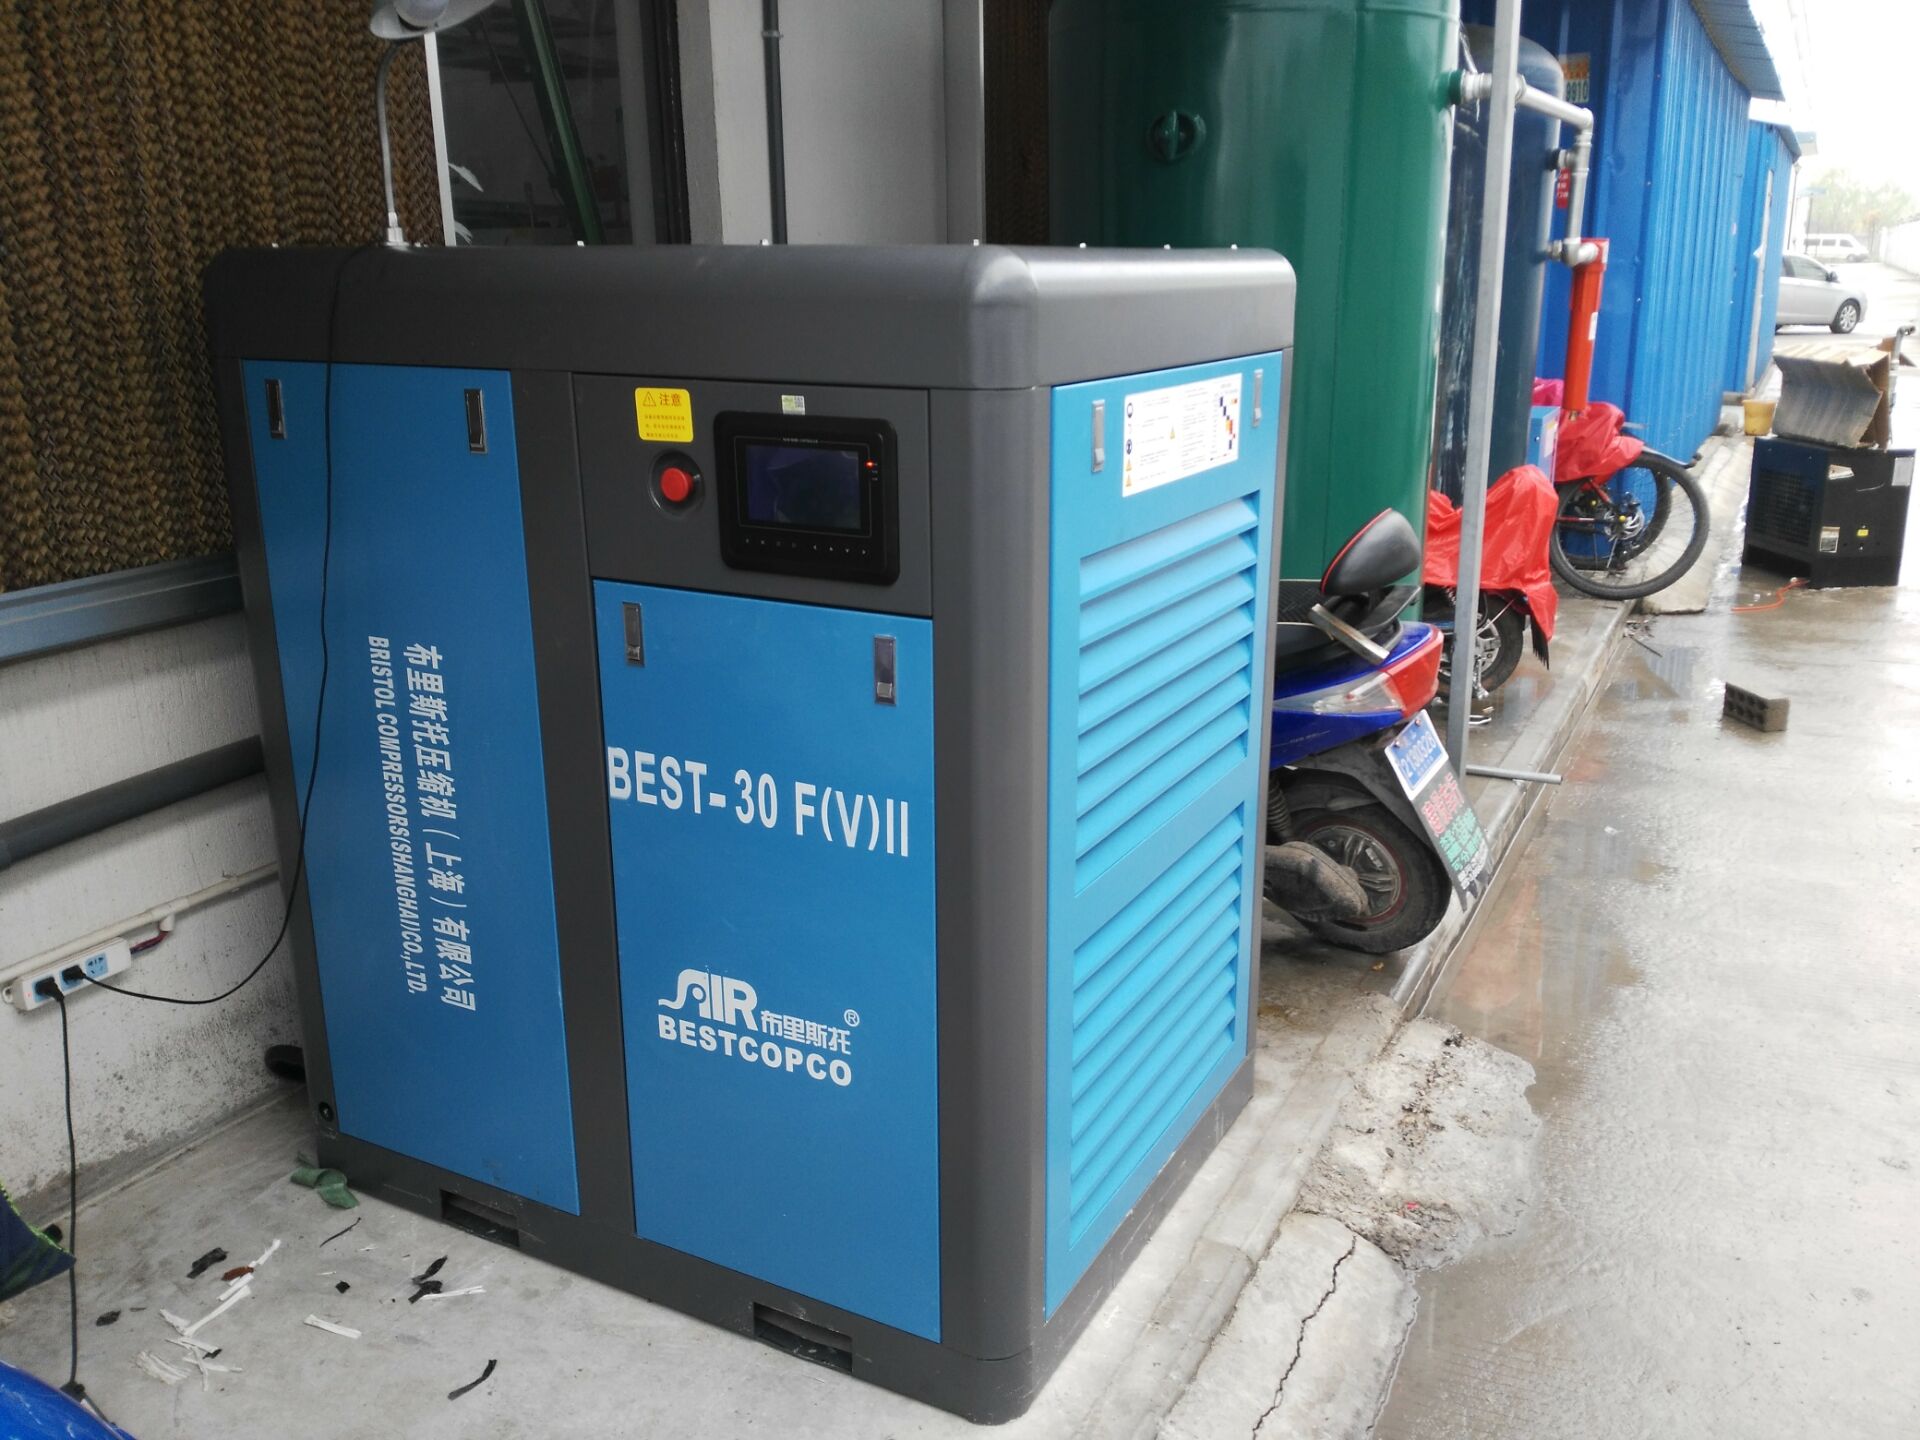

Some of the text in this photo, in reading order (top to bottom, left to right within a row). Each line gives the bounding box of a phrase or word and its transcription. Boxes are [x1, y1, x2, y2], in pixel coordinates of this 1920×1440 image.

[659, 391, 682, 407] 注意
[368, 635, 396, 709] BRISTOL
[657, 1014, 852, 1087] BESTCOPCO
[760, 1009, 852, 1055] 布里斯托
